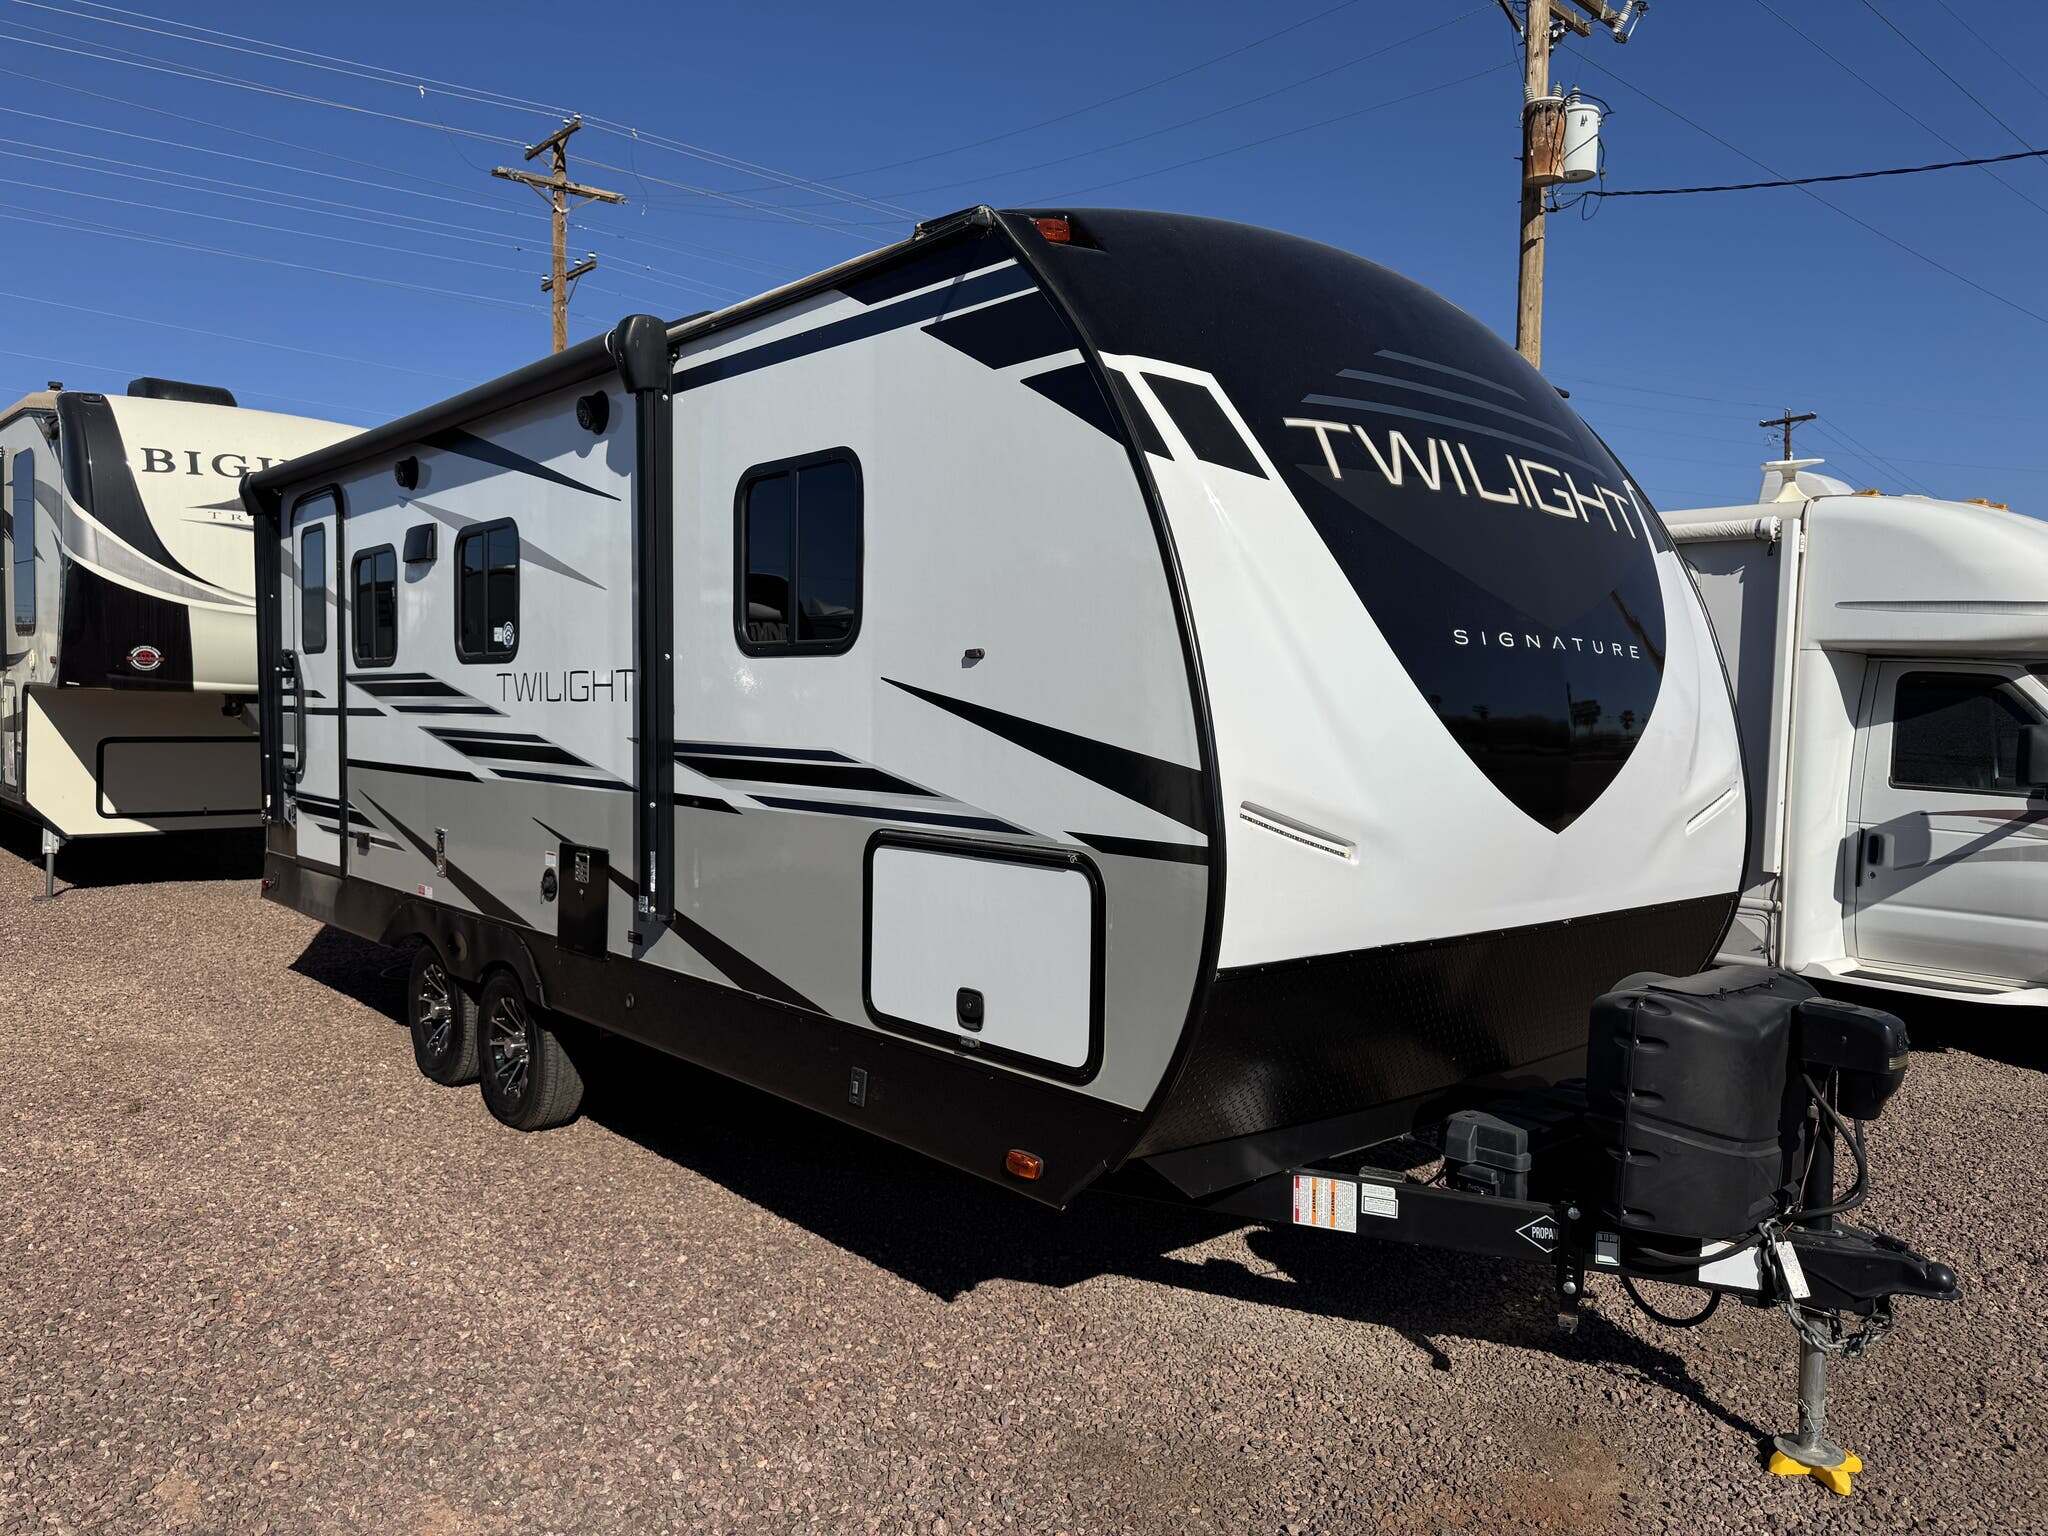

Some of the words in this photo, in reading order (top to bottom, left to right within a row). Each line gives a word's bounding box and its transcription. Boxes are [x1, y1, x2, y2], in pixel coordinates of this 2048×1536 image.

[1283, 417, 1636, 540] TWILIGHT
[207, 511, 243, 522] TR
[1453, 629, 1640, 659] SIGNATURE
[496, 669, 636, 702] TWILIGHT
[1531, 1226, 1559, 1240] PROPAN
